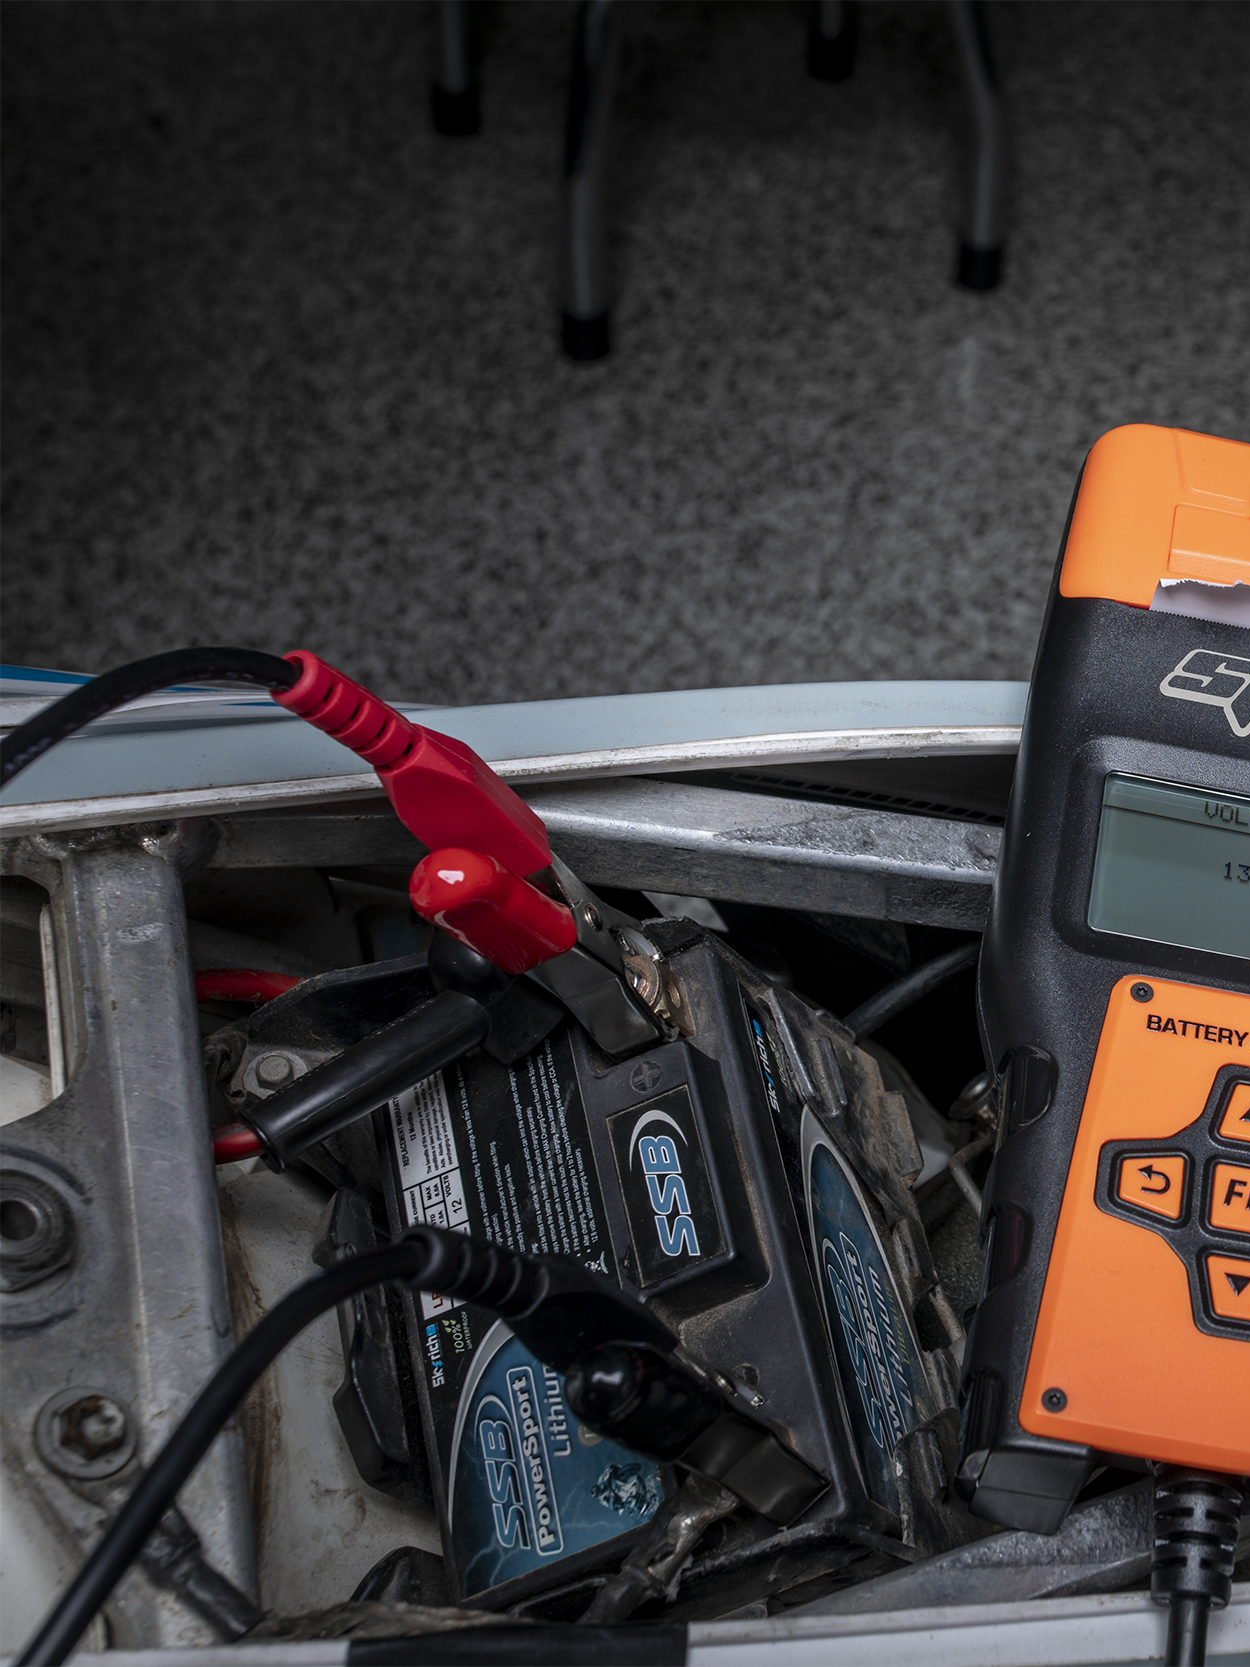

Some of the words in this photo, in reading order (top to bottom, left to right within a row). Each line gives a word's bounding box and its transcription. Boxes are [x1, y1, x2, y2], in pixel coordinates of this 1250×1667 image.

[1146, 1014, 1249, 1048] BATTERY
[405, 1110, 415, 1133] Months
[409, 1132, 417, 1141] 12
[424, 1184, 432, 1201] MAX
[442, 1174, 452, 1197] VOLTS
[638, 1135, 700, 1257] SSB
[409, 1188, 418, 1215] CURRENT
[450, 1197, 463, 1214] 12
[452, 1323, 465, 1354] 100%
[847, 1250, 903, 1443] owerSport
[512, 1375, 556, 1547] PowerSport
[479, 1419, 531, 1550] SSB
